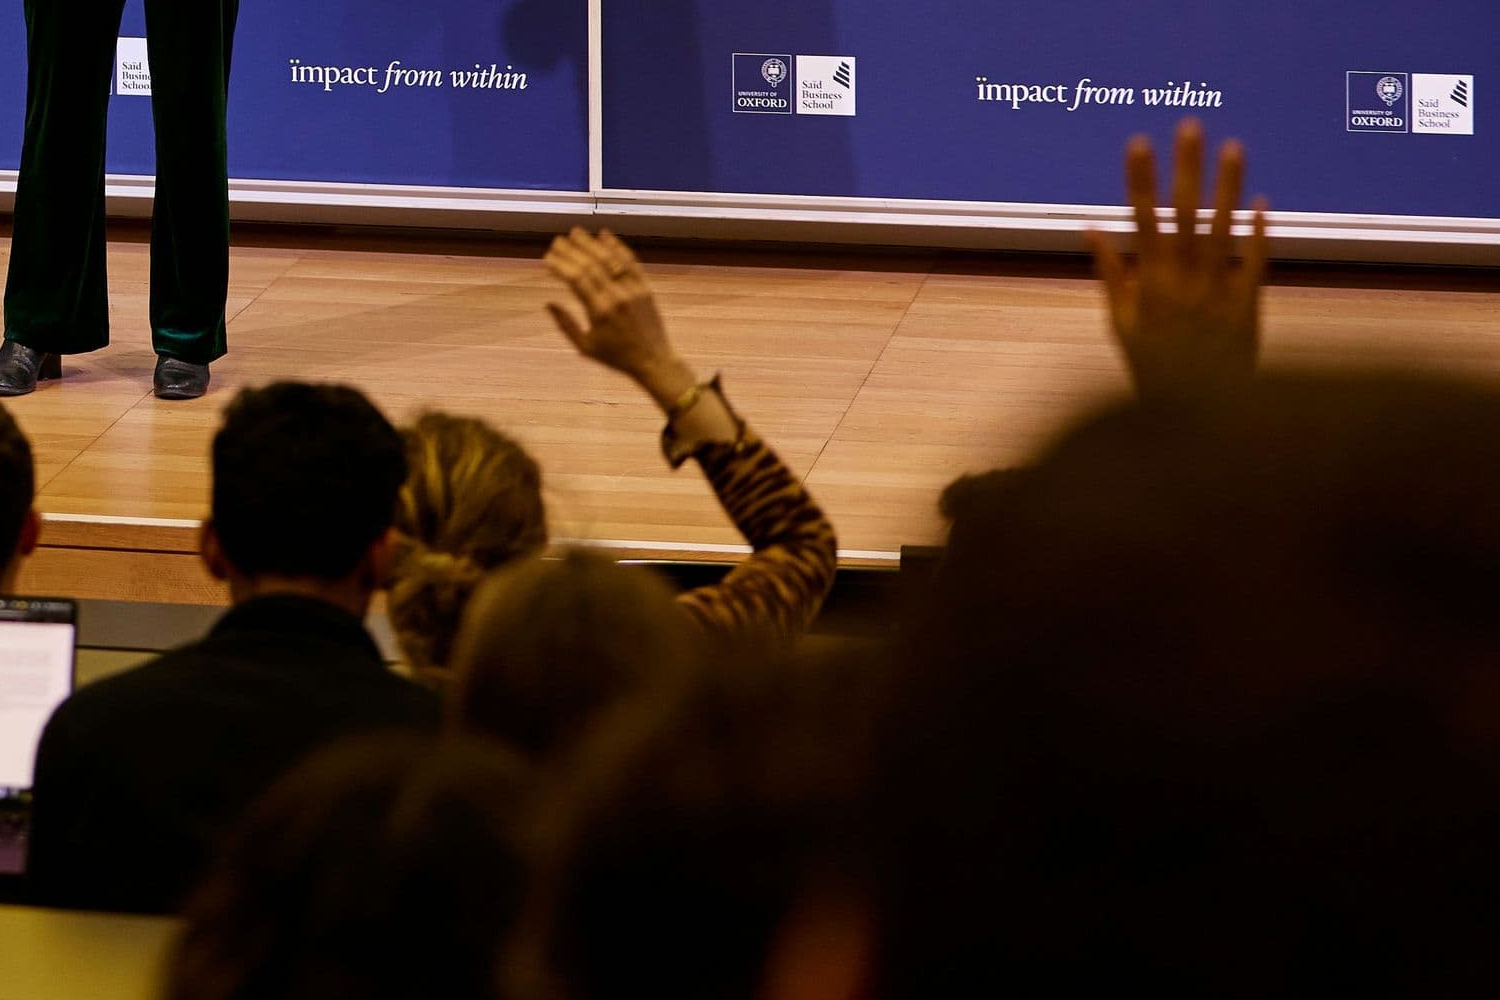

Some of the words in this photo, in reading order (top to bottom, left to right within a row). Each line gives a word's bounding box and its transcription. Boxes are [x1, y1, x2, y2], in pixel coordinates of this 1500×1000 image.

[122, 72, 151, 80] Busine
[377, 61, 443, 93] from
[449, 64, 527, 89] within
[122, 81, 151, 89] Schoo
[803, 91, 842, 99] Business
[1067, 78, 1135, 111] from
[1141, 82, 1222, 107] within
[738, 98, 787, 108] OXFORD
[803, 100, 833, 109] School
[1352, 117, 1403, 127] OXFORD
[1419, 119, 1450, 128] School
